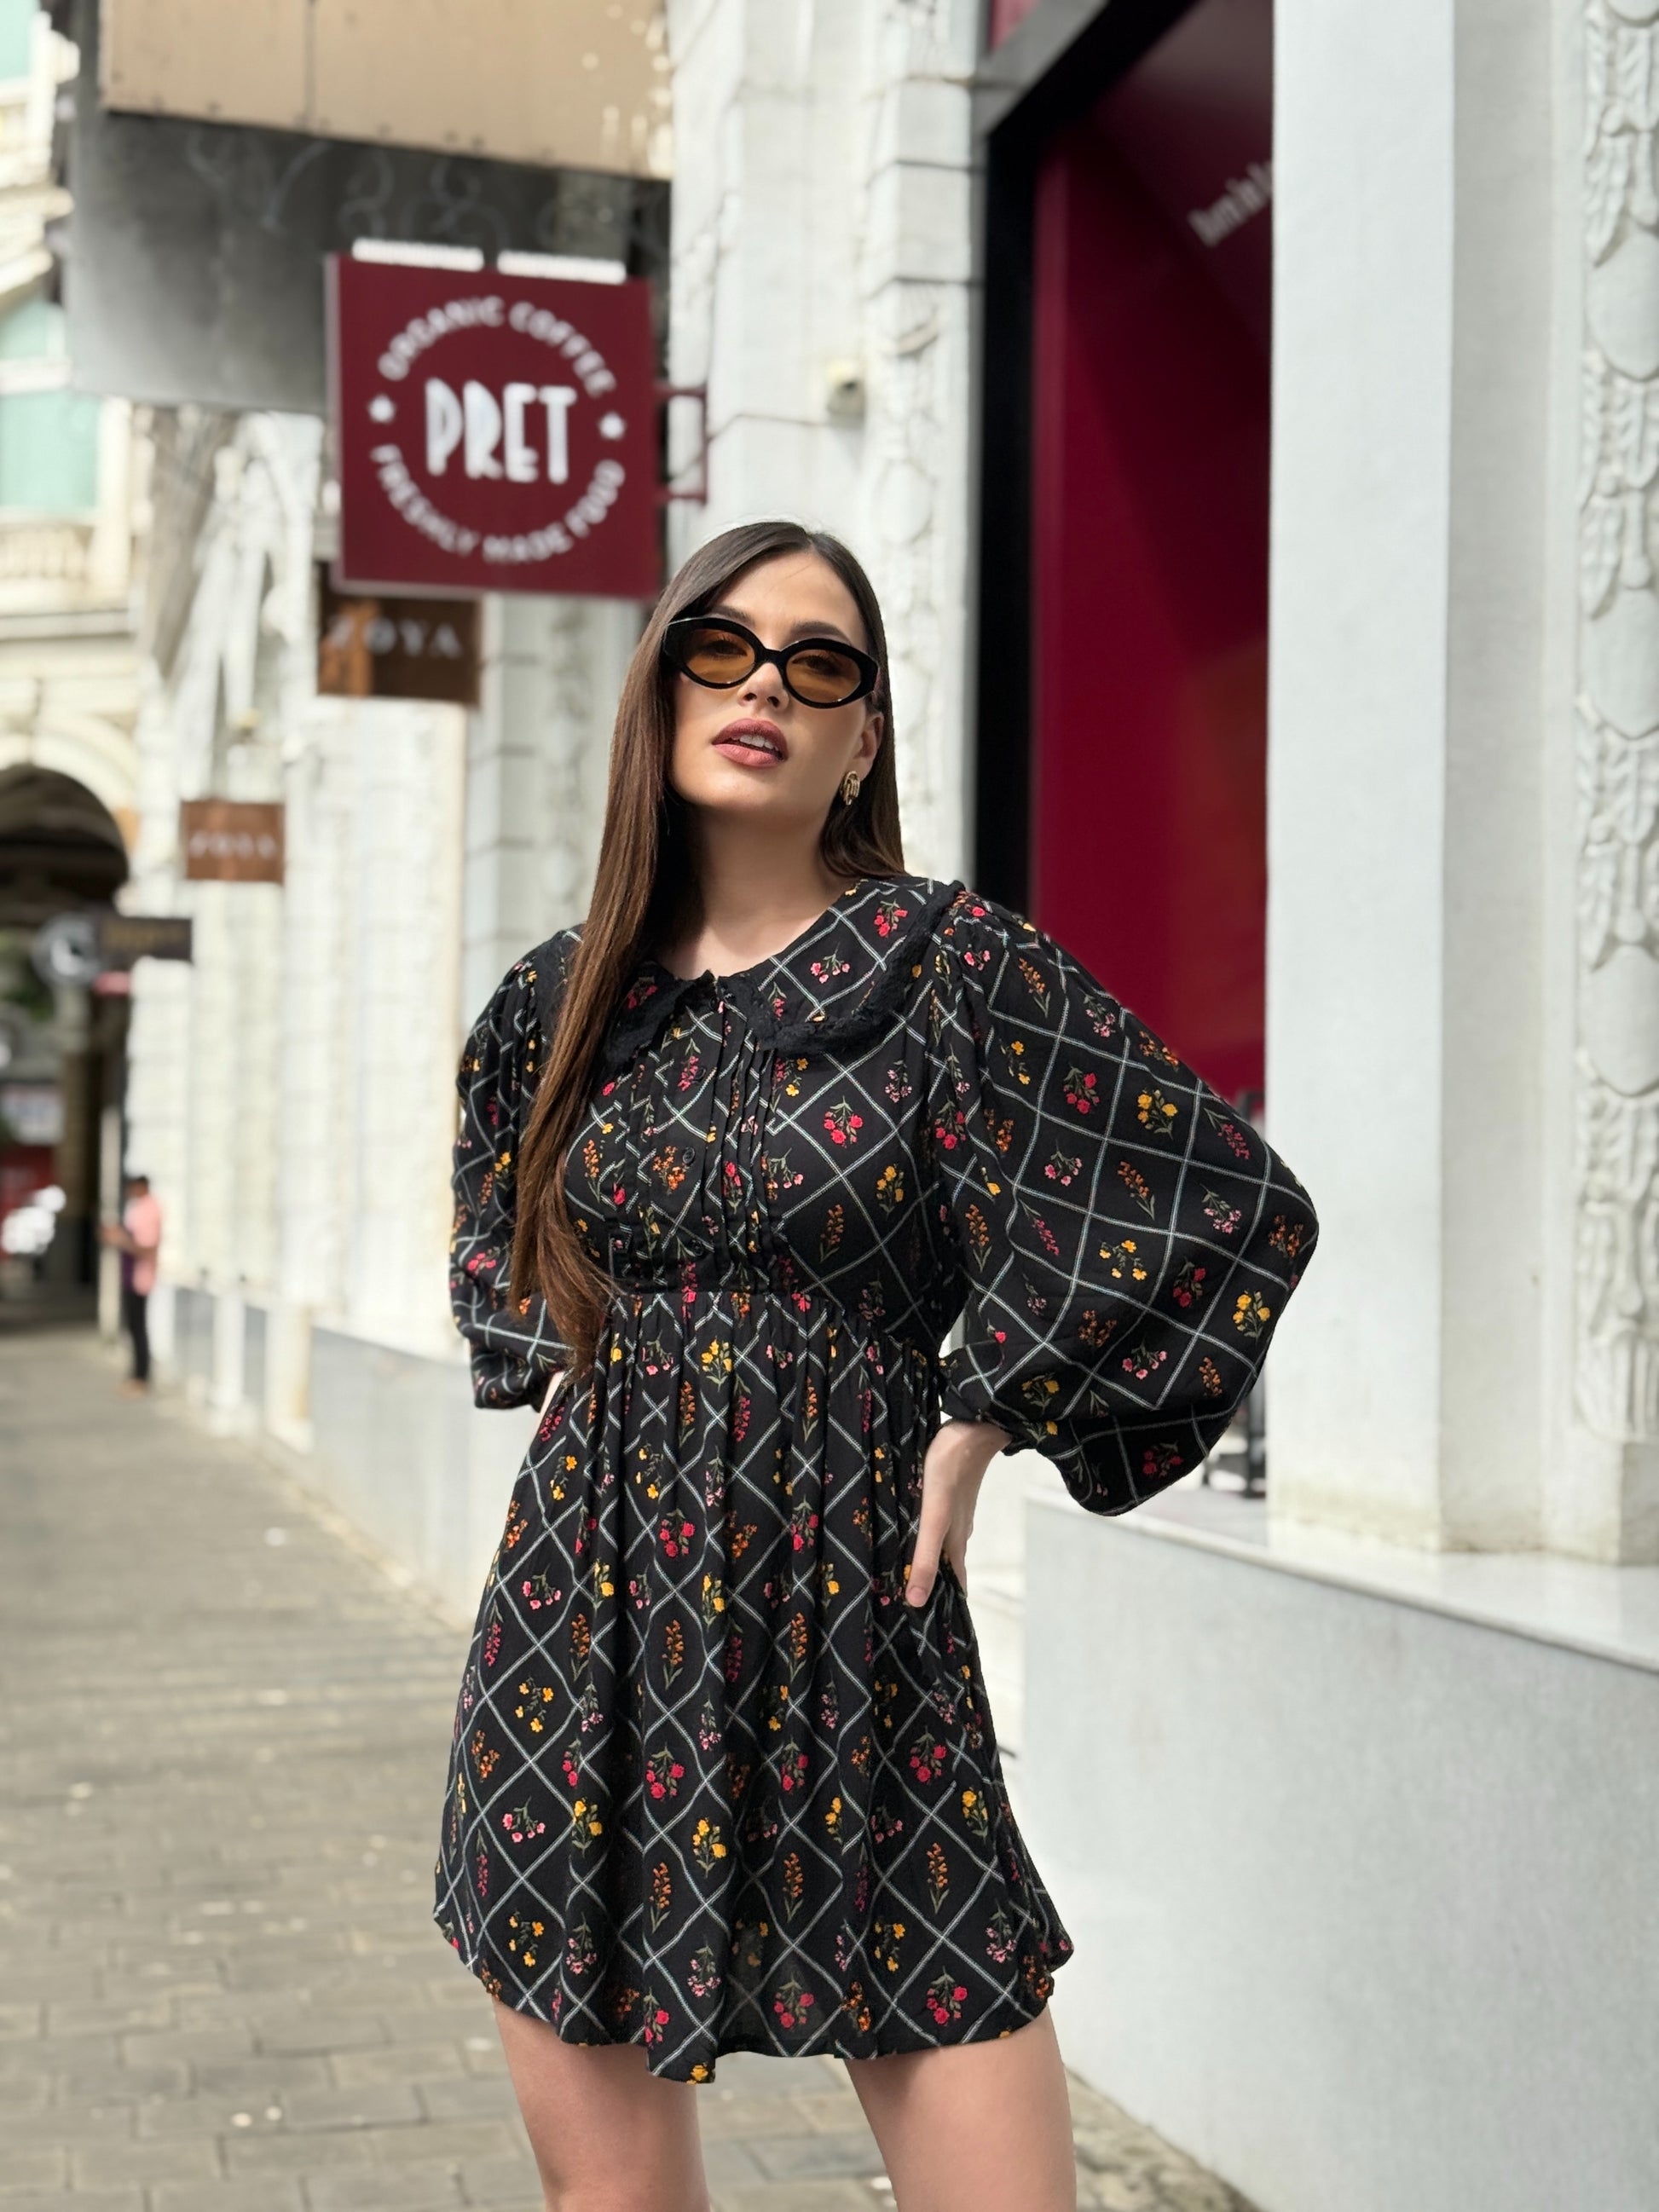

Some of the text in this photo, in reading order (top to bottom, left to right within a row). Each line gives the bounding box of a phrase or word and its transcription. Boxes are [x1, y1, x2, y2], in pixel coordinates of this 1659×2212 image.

[378, 296, 616, 397] ORGANIC COFFEE
[425, 377, 577, 484] PRET
[370, 443, 625, 563] FRESHLY MADE FOOD
